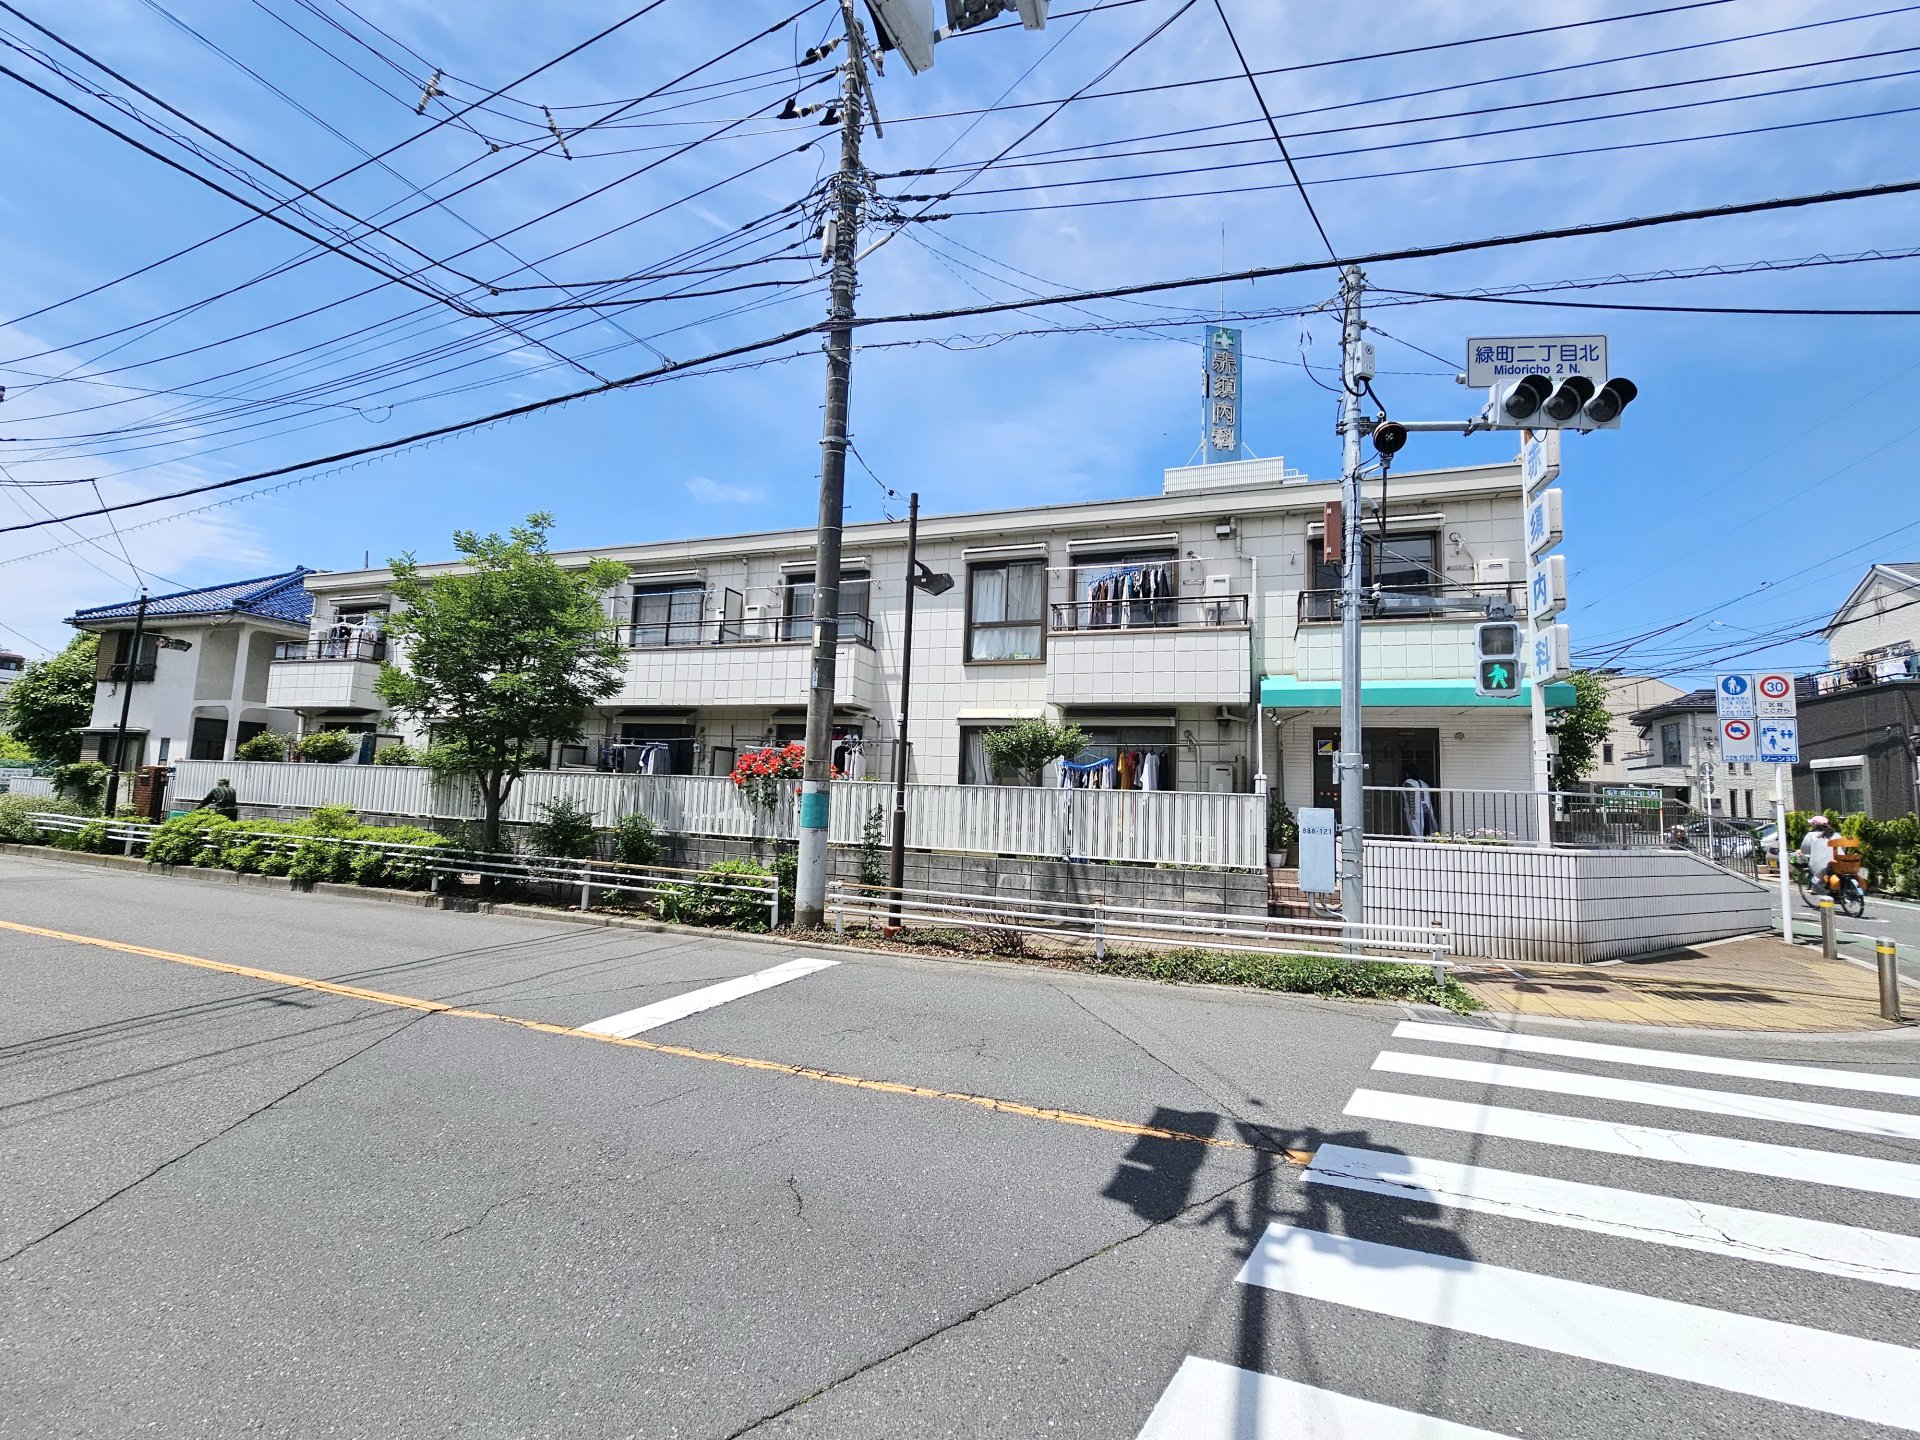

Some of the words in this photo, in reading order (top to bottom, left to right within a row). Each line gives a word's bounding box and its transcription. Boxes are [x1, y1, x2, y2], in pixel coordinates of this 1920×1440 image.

[1475, 344, 1600, 364] 緑町二丁目北
[1494, 364, 1550, 375] Midoricho
[1556, 363, 1563, 374] 2
[1569, 363, 1581, 374] N.
[1212, 351, 1237, 451] 赤須内科
[1767, 682, 1783, 692] 30
